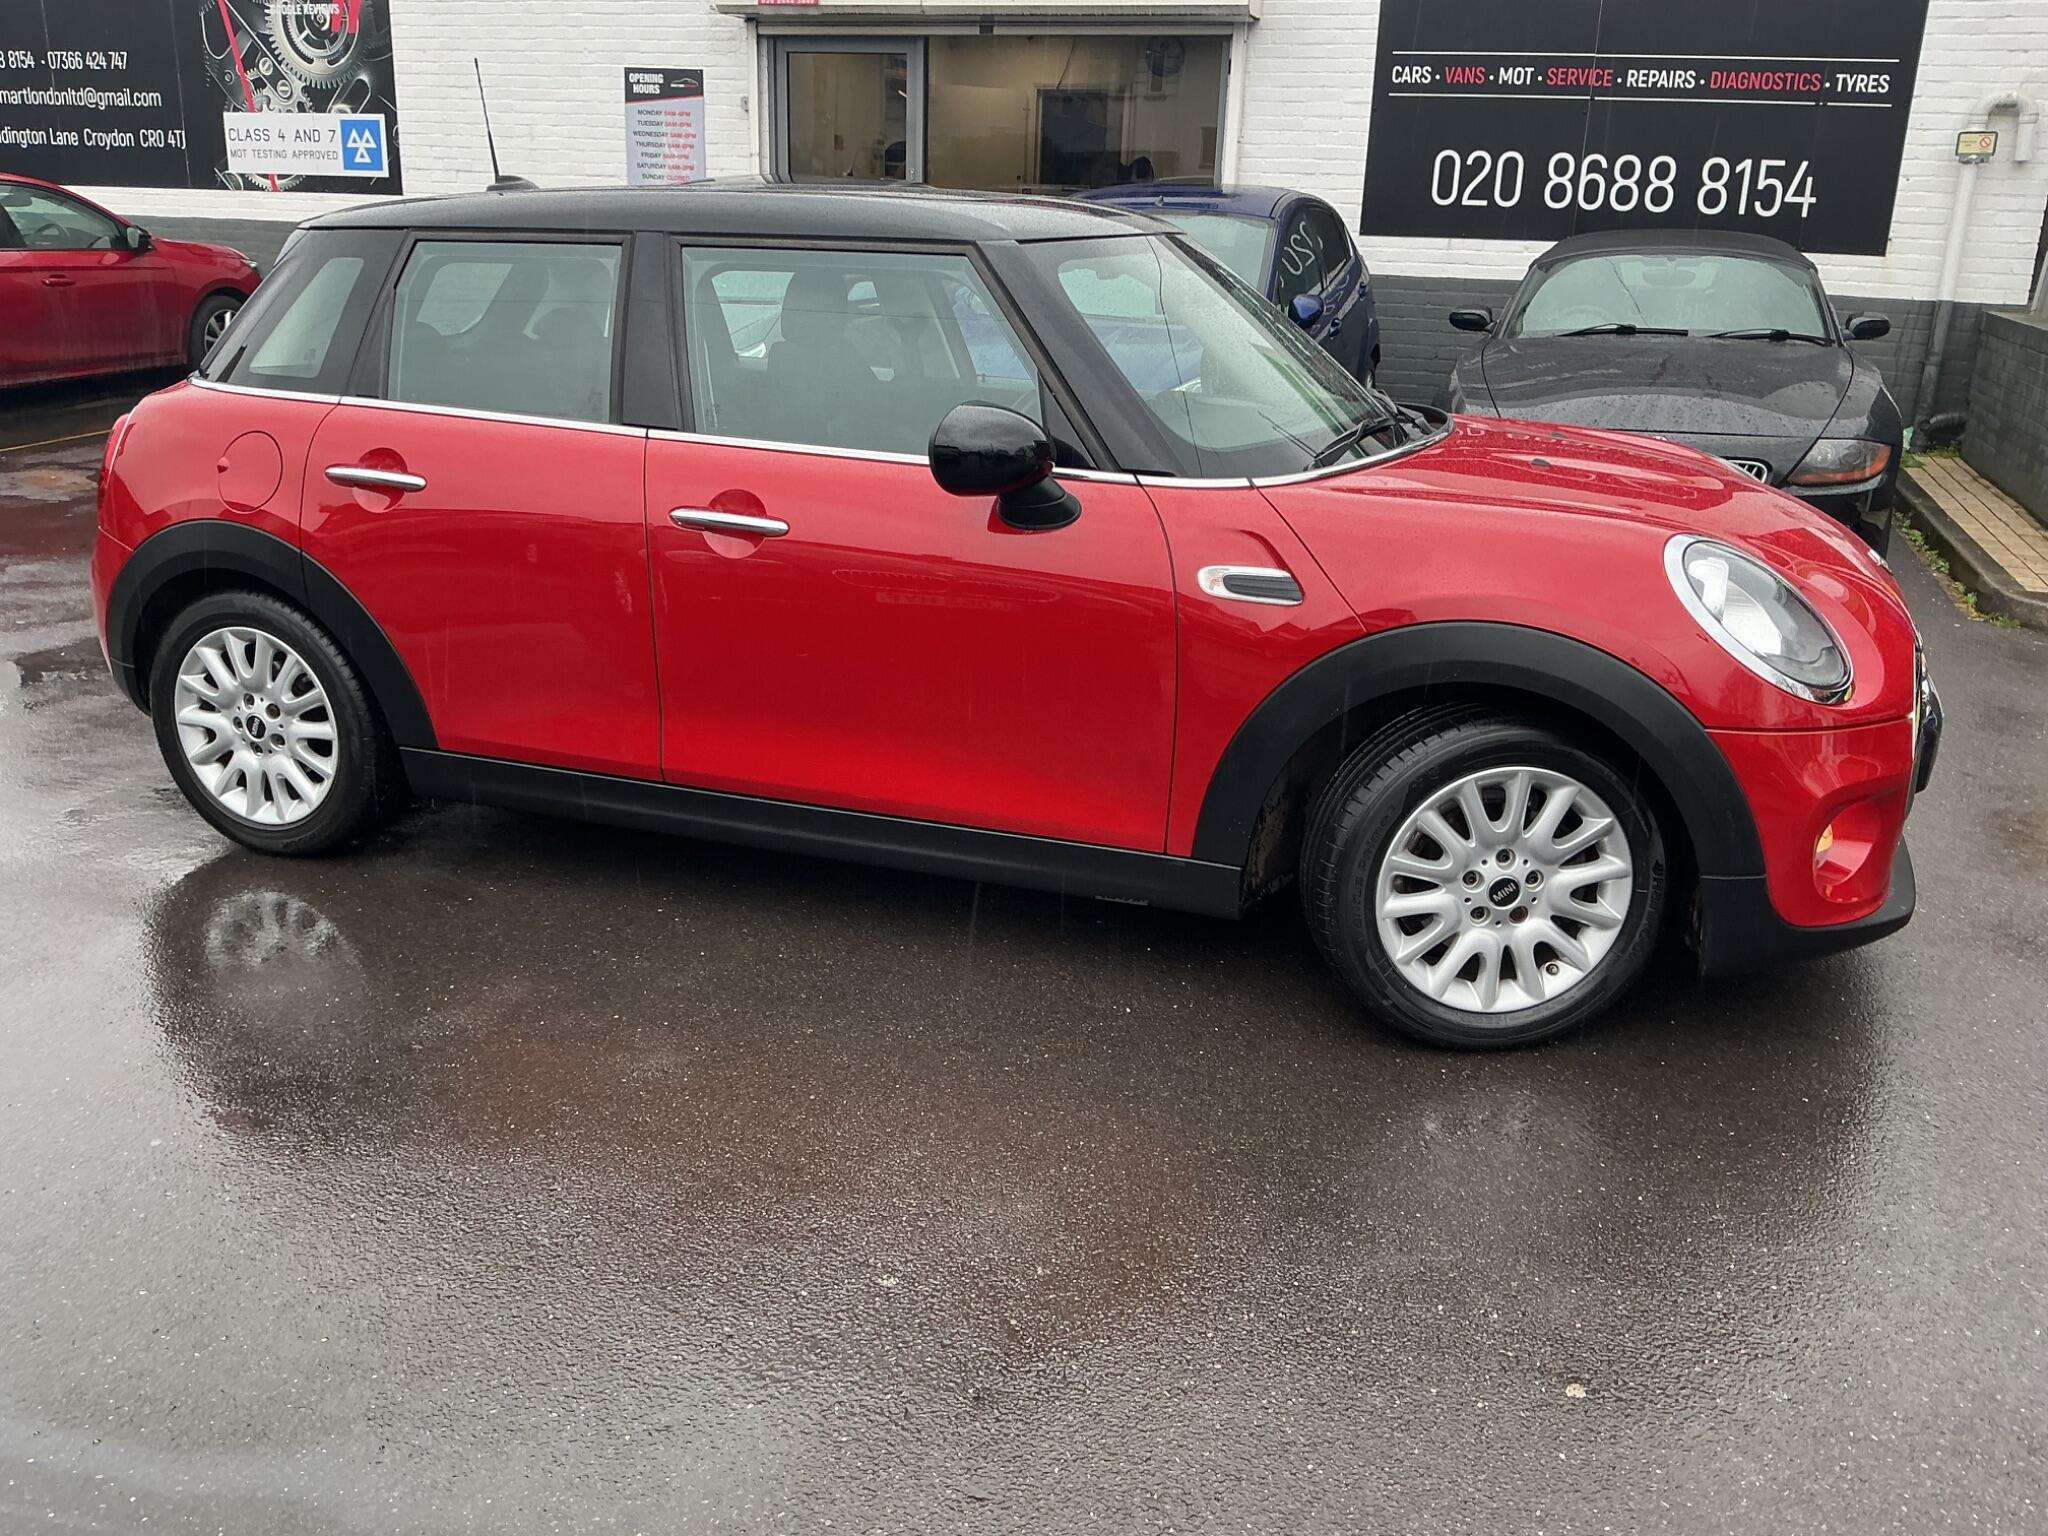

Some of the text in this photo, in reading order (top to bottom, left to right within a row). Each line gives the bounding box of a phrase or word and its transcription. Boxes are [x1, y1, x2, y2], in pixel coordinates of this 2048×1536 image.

[303, 3, 340, 15] REVIEWS
[7, 50, 35, 69] 8154
[47, 51, 83, 70] 07366
[86, 52, 107, 70] 424
[110, 52, 128, 70] 747
[629, 72, 664, 84] OPENING
[1392, 65, 1890, 94] CARS VANS MOT SERVICE REPAIRS DIAGNOSTICS TYRES
[633, 83, 660, 94] HOURS
[637, 109, 662, 117] MONDAY
[0, 126, 47, 148] dington
[49, 127, 79, 146] Lane
[83, 128, 135, 150] Croydon
[167, 130, 187, 150] 4TJ
[228, 128, 337, 143] CLASS 4 AND 7
[636, 141, 666, 149] THURSDAY
[230, 149, 339, 161] MOT TESTING APPROVED
[636, 162, 666, 170] SATURDAY
[1430, 148, 1818, 219] 020 8688 8154
[1492, 882, 1517, 902] MINI
